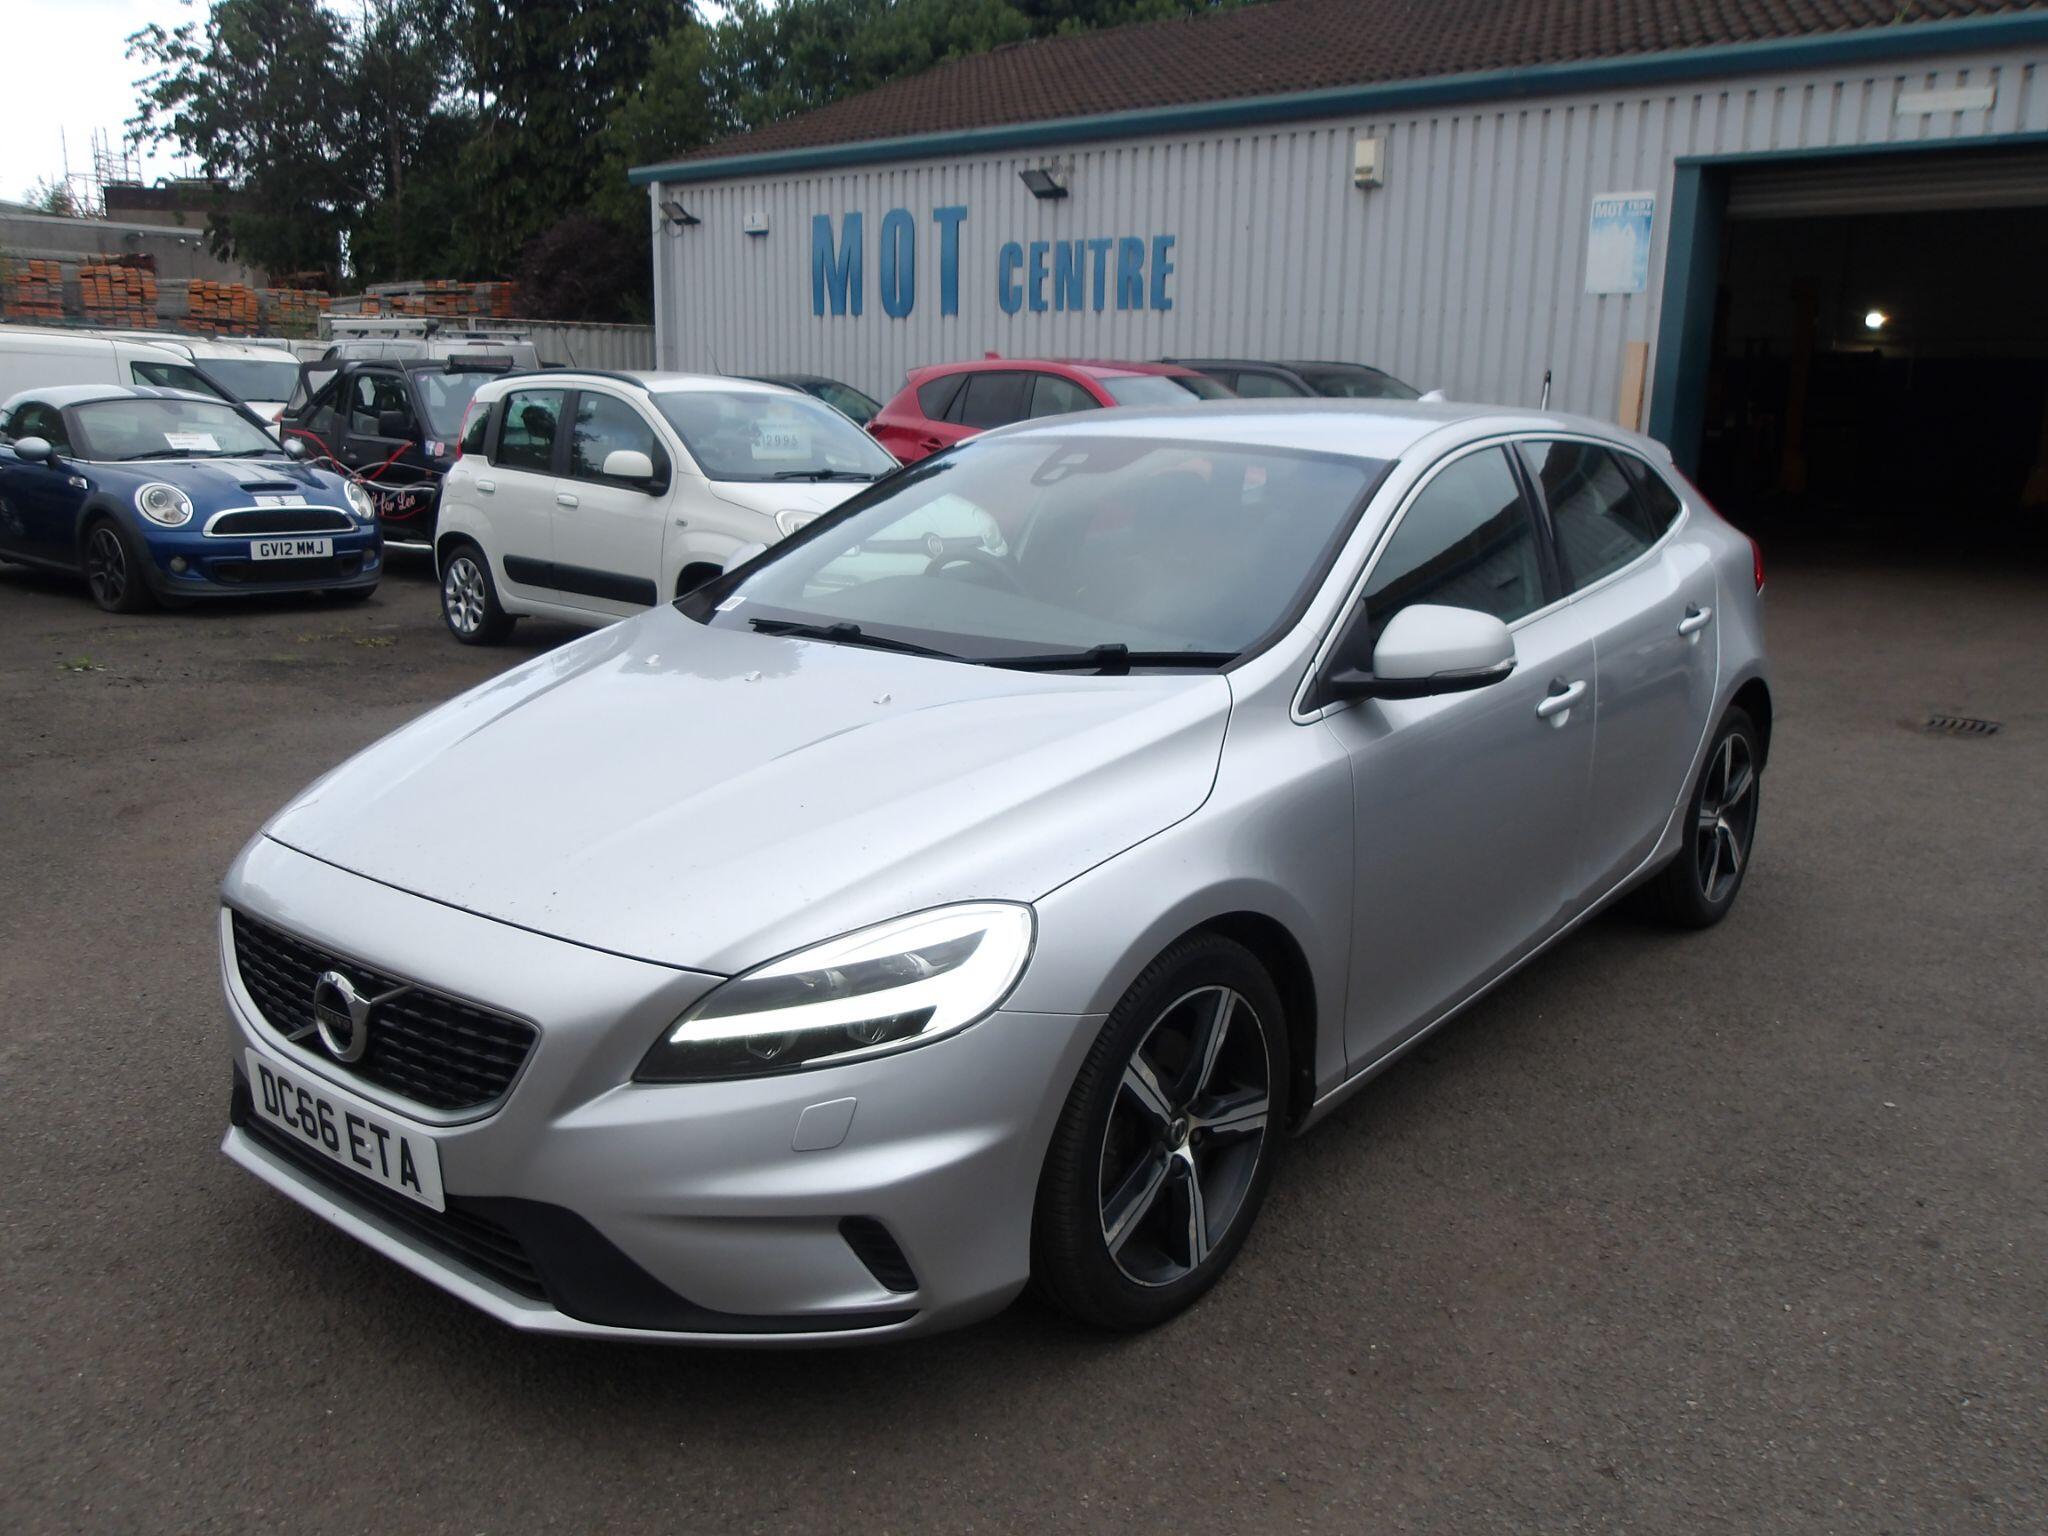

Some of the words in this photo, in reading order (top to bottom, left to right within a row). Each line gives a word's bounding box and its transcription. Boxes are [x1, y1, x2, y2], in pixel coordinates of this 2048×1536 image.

[1595, 202, 1624, 217] MOT
[812, 206, 968, 319] MOT
[998, 235, 1175, 315] CENTRE
[260, 542, 293, 557] GV12
[297, 540, 324, 555] MMJ
[258, 1063, 340, 1152] DC66
[345, 1111, 422, 1194] ETA
